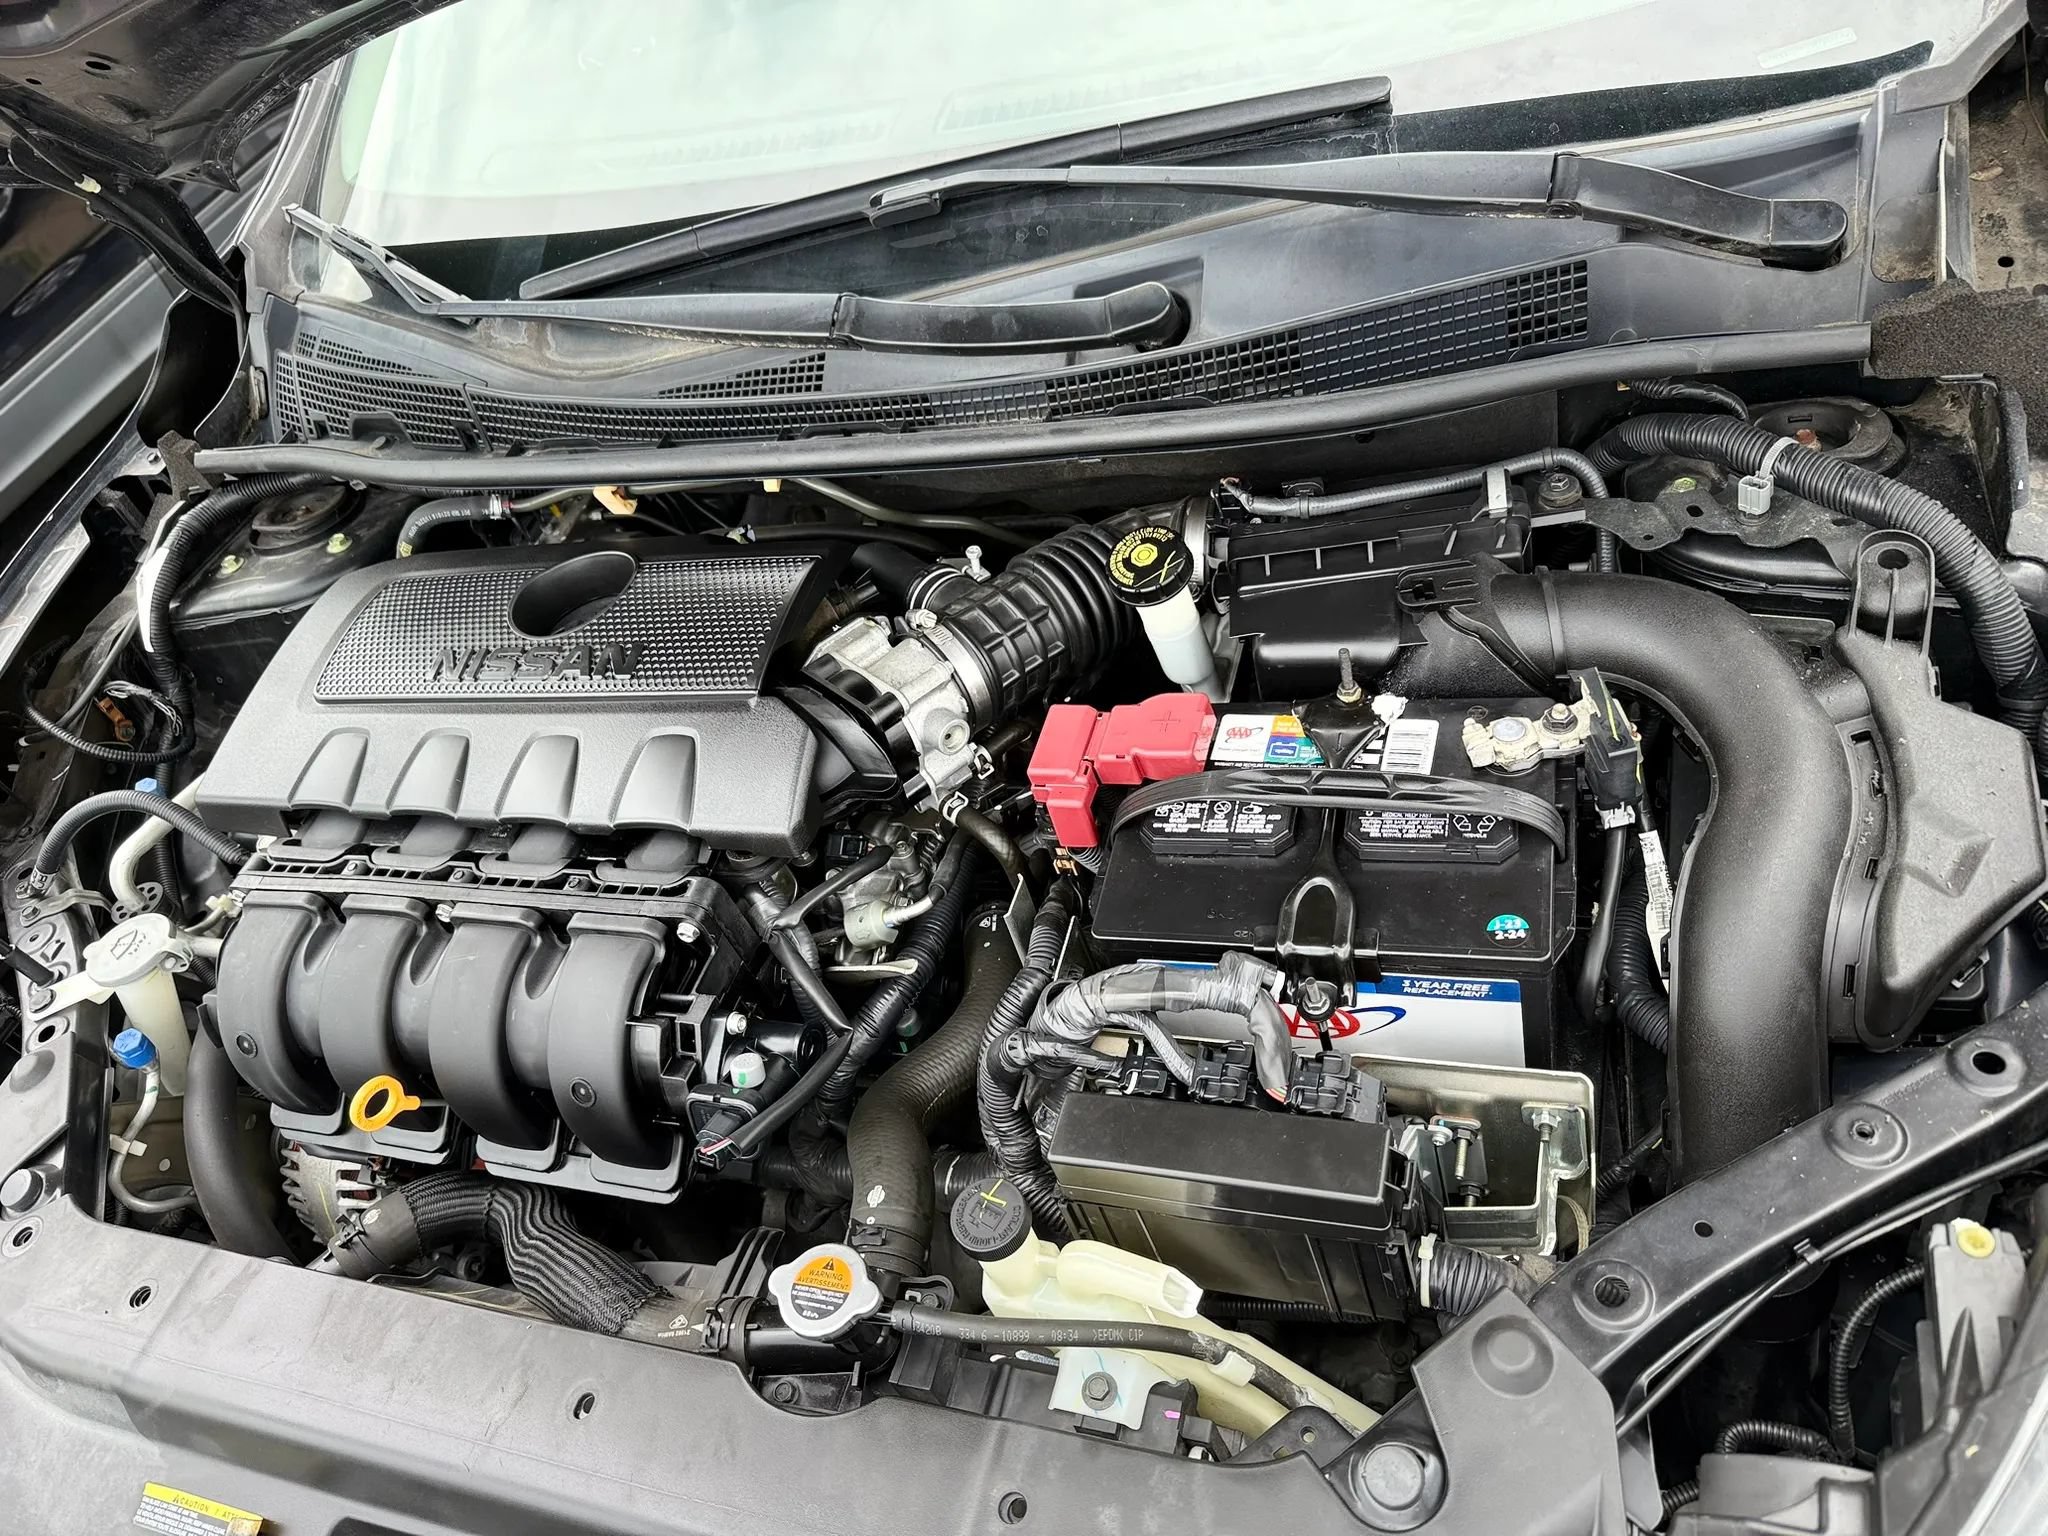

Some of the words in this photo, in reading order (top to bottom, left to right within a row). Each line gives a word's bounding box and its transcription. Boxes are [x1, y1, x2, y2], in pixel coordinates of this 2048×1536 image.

[428, 642, 645, 683] NISSAN
[1227, 726, 1251, 738] AAA
[1495, 929, 1526, 940] 2-24
[1414, 981, 1450, 990] YEAR
[1454, 983, 1491, 992] FREE
[809, 1269, 843, 1281] WARNING
[180, 1496, 209, 1512] CAUTION
